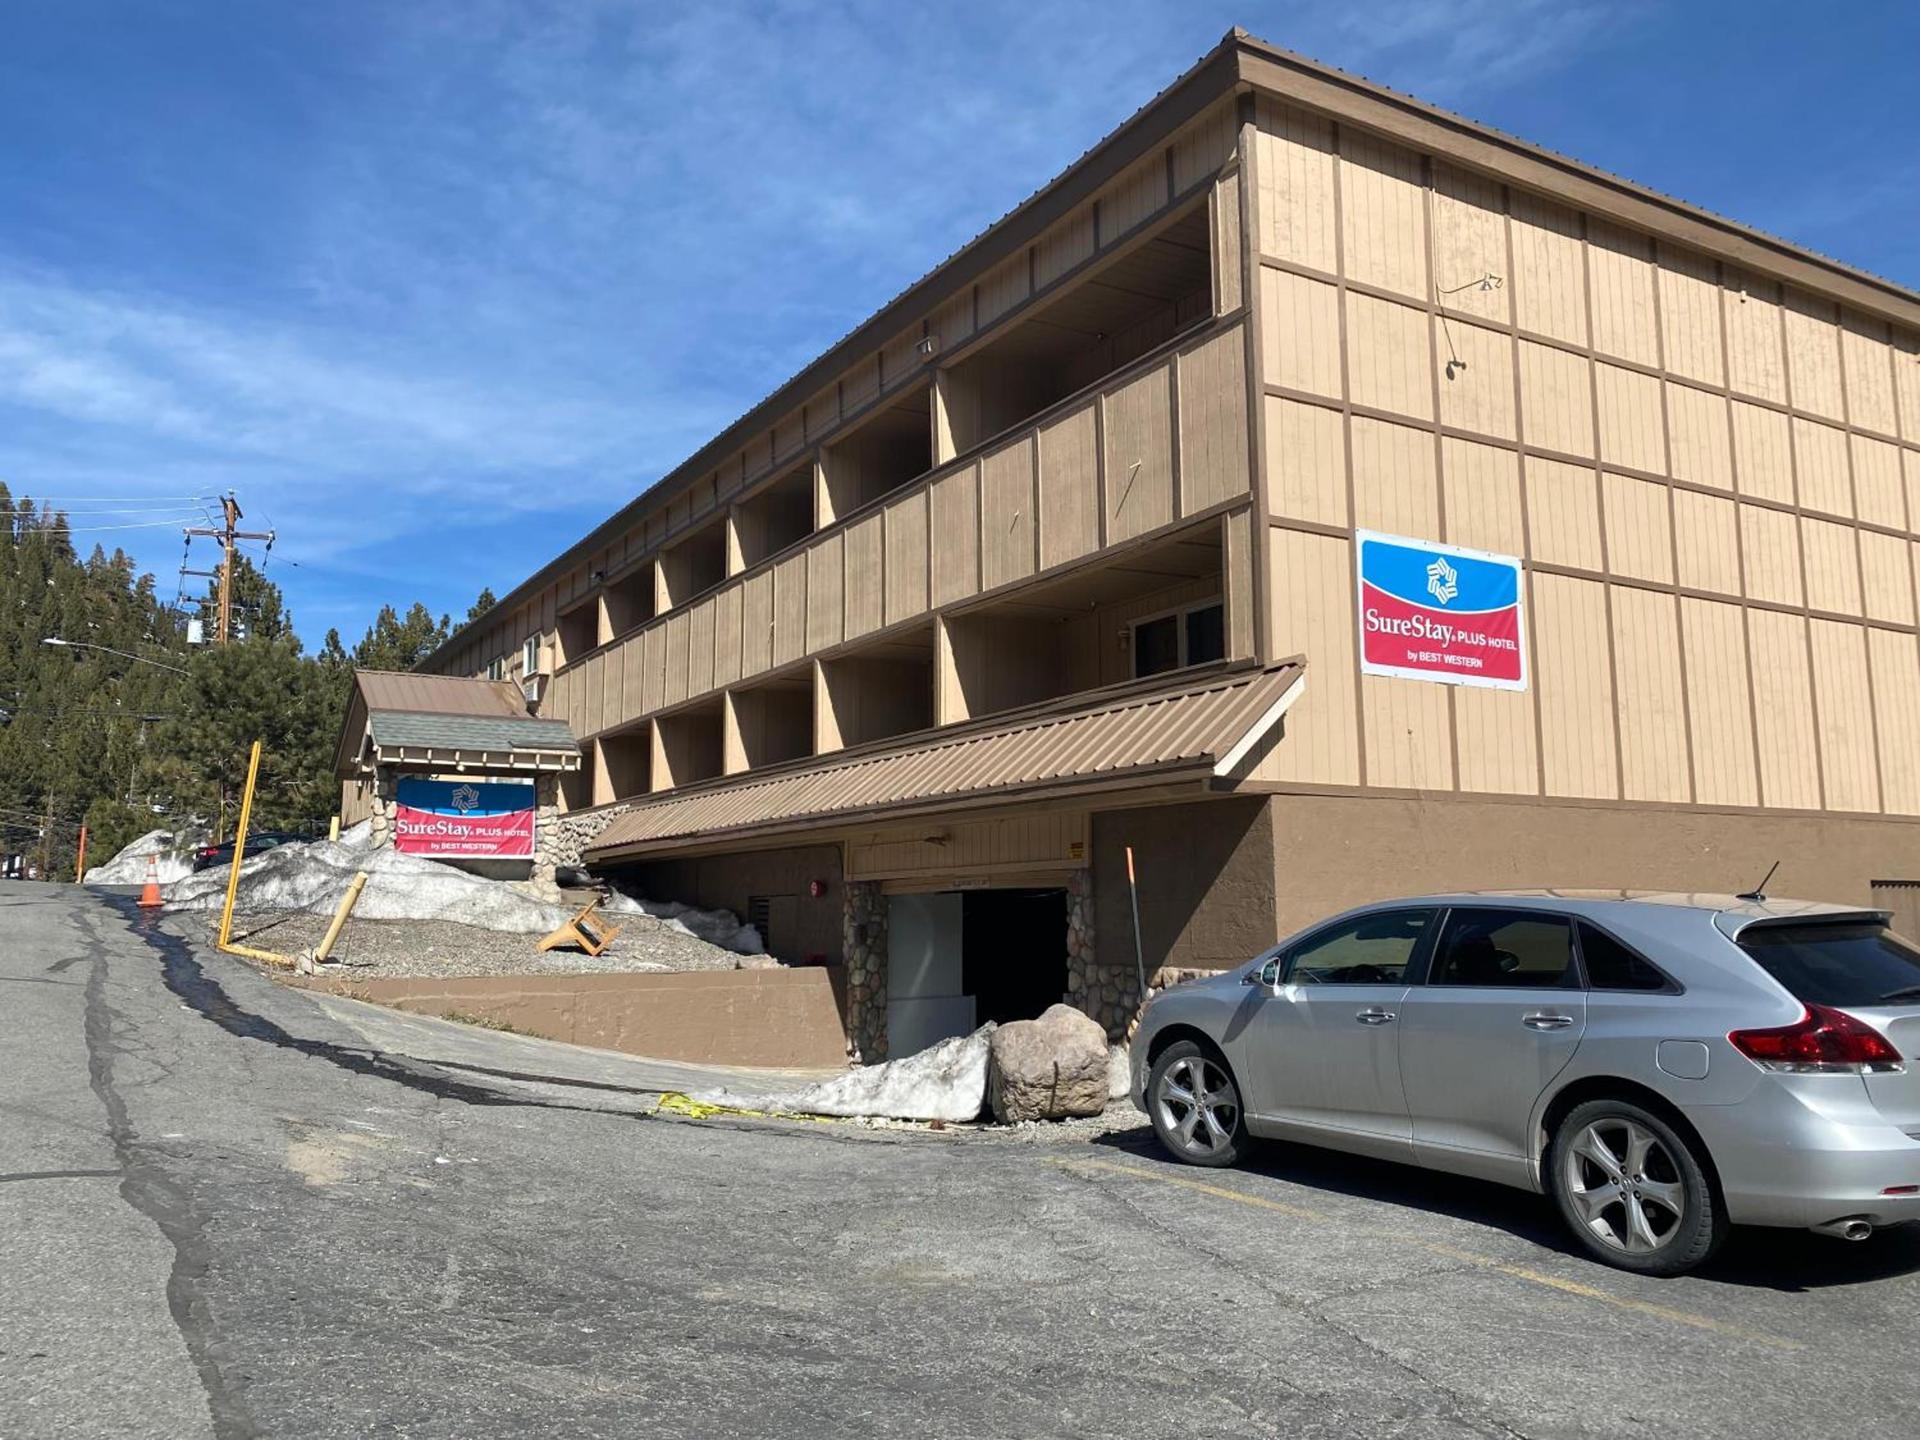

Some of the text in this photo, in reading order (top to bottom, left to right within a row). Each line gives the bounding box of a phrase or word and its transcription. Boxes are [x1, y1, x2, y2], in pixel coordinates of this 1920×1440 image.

[1366, 608, 1517, 650] SureStay PLUS HOTEL
[1407, 650, 1483, 668] by BEST WESTERN
[397, 820, 471, 840] SureStay
[476, 828, 502, 837] PLUS
